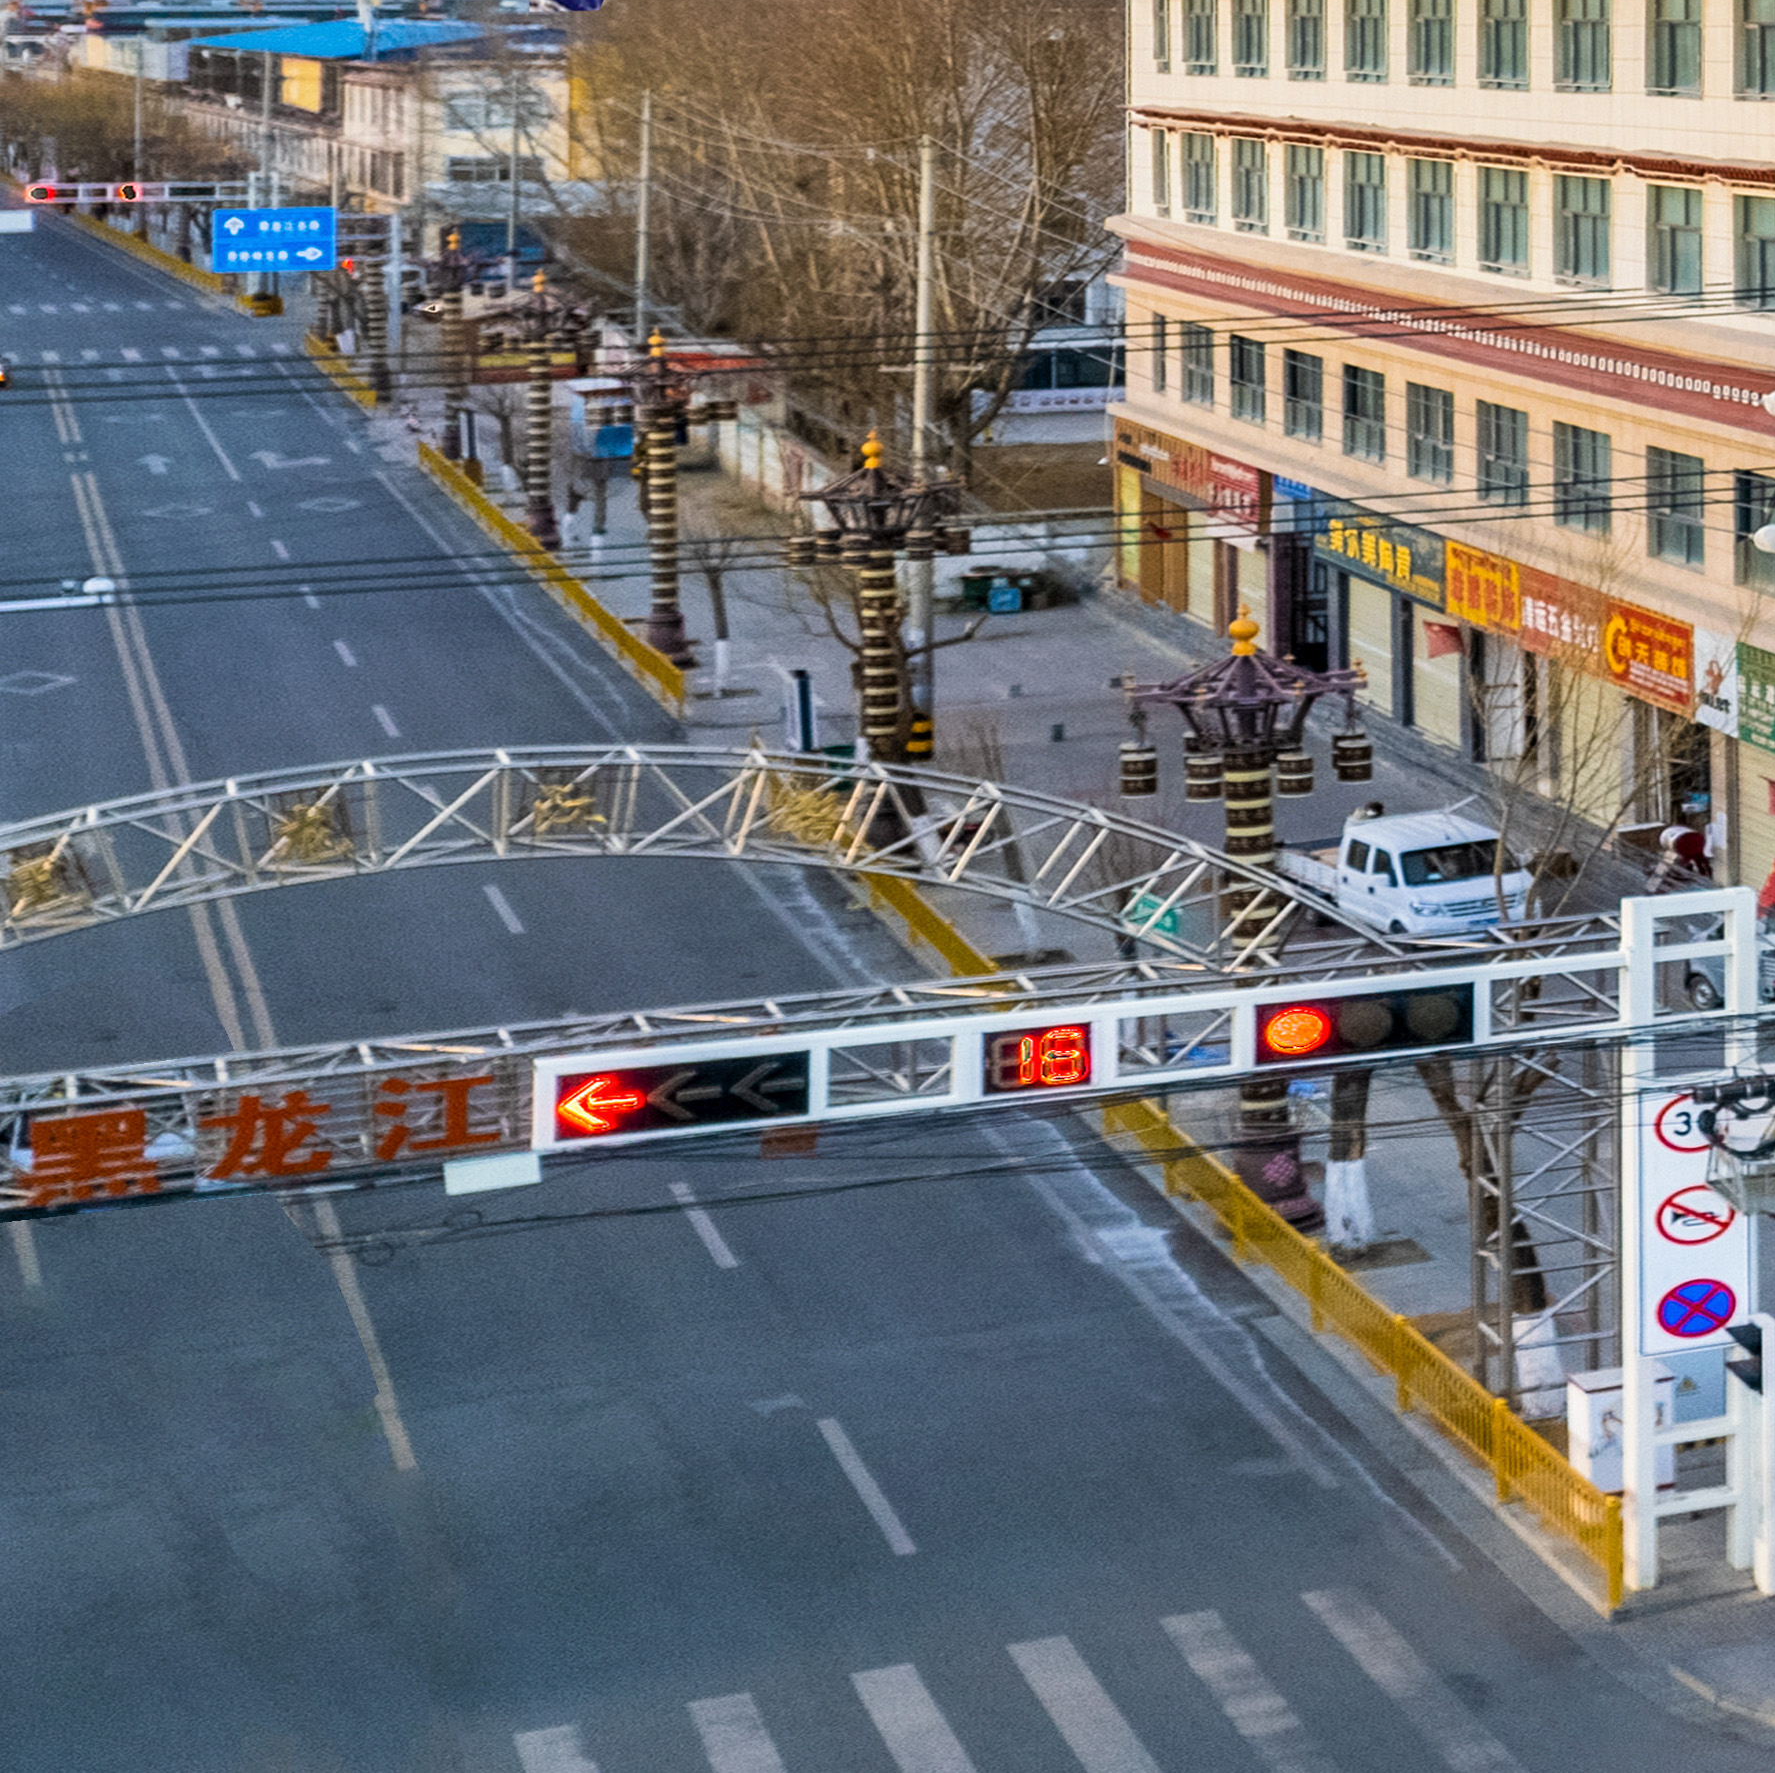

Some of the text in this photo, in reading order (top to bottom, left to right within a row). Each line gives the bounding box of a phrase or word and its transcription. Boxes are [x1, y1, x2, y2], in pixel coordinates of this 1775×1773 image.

[1020, 1026, 1090, 1086] 16
[20, 1074, 502, 1208] 黑龙江
